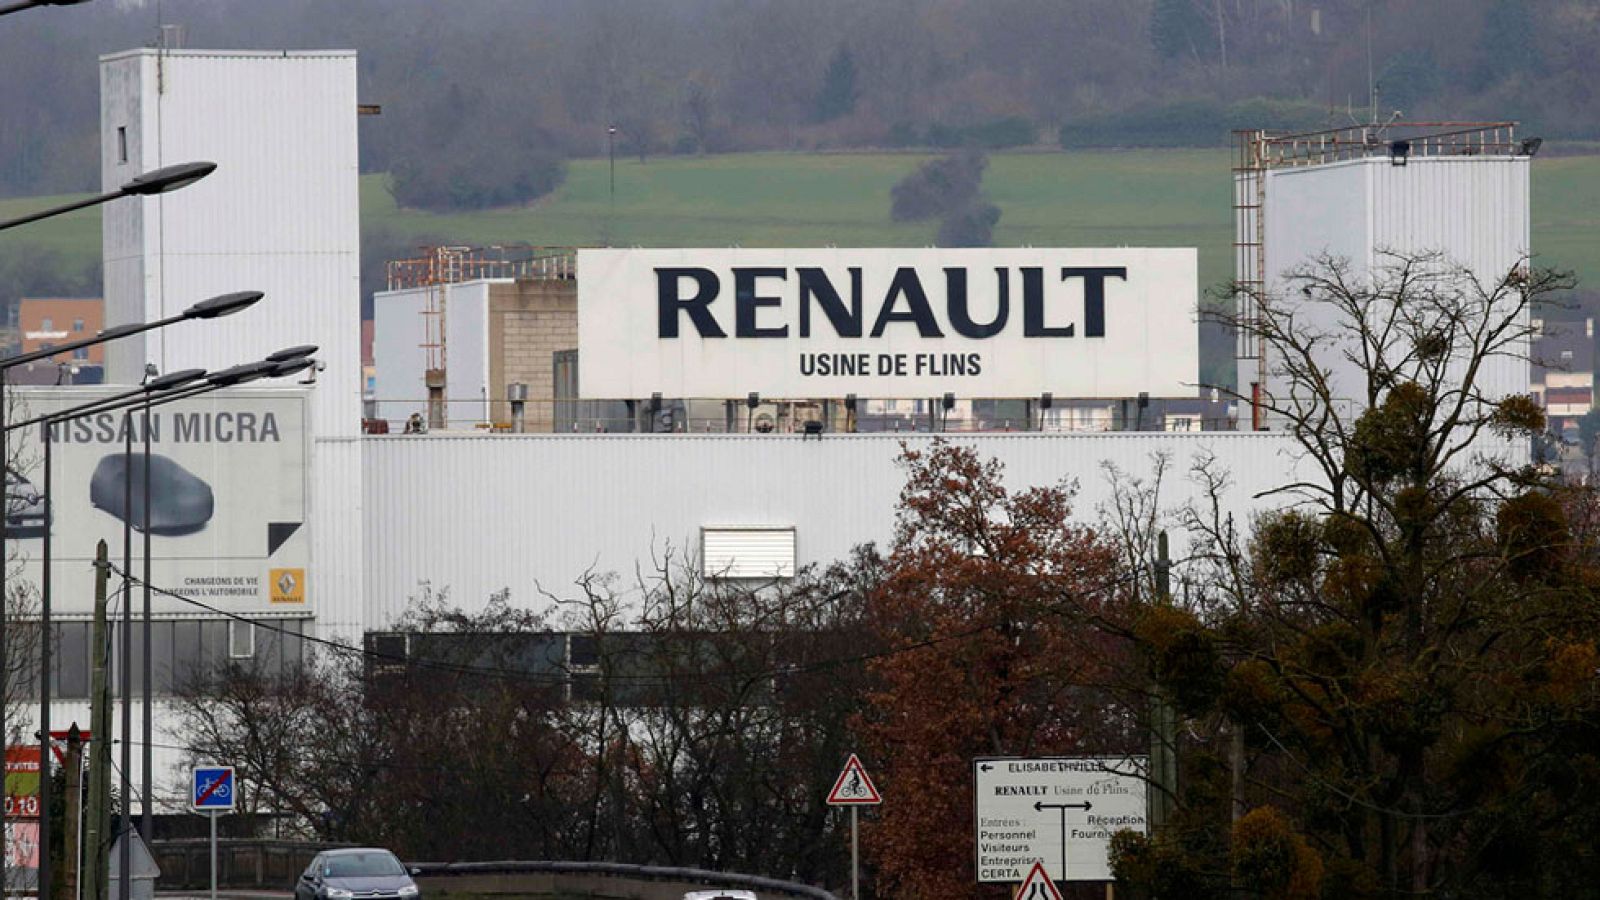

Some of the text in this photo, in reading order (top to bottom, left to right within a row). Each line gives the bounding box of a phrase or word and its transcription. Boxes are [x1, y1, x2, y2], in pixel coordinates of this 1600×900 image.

[652, 266, 1127, 339] RENAULT
[800, 353, 981, 377] USINE DE FLINS
[40, 412, 281, 443] NISSAN MICRA
[184, 577, 258, 586] CHANGEONS DE VIE
[201, 587, 258, 597] L'AUTOMOBILE
[1008, 762, 1105, 773] ELISABETHVILLE
[995, 786, 1048, 796] RENAULT
[1054, 786, 1083, 796] Usine
[980, 829, 1036, 840] Personnel
[1071, 829, 1112, 839] Fournis
[980, 843, 1030, 853] Visiteurs
[981, 868, 1021, 879] CERTA
